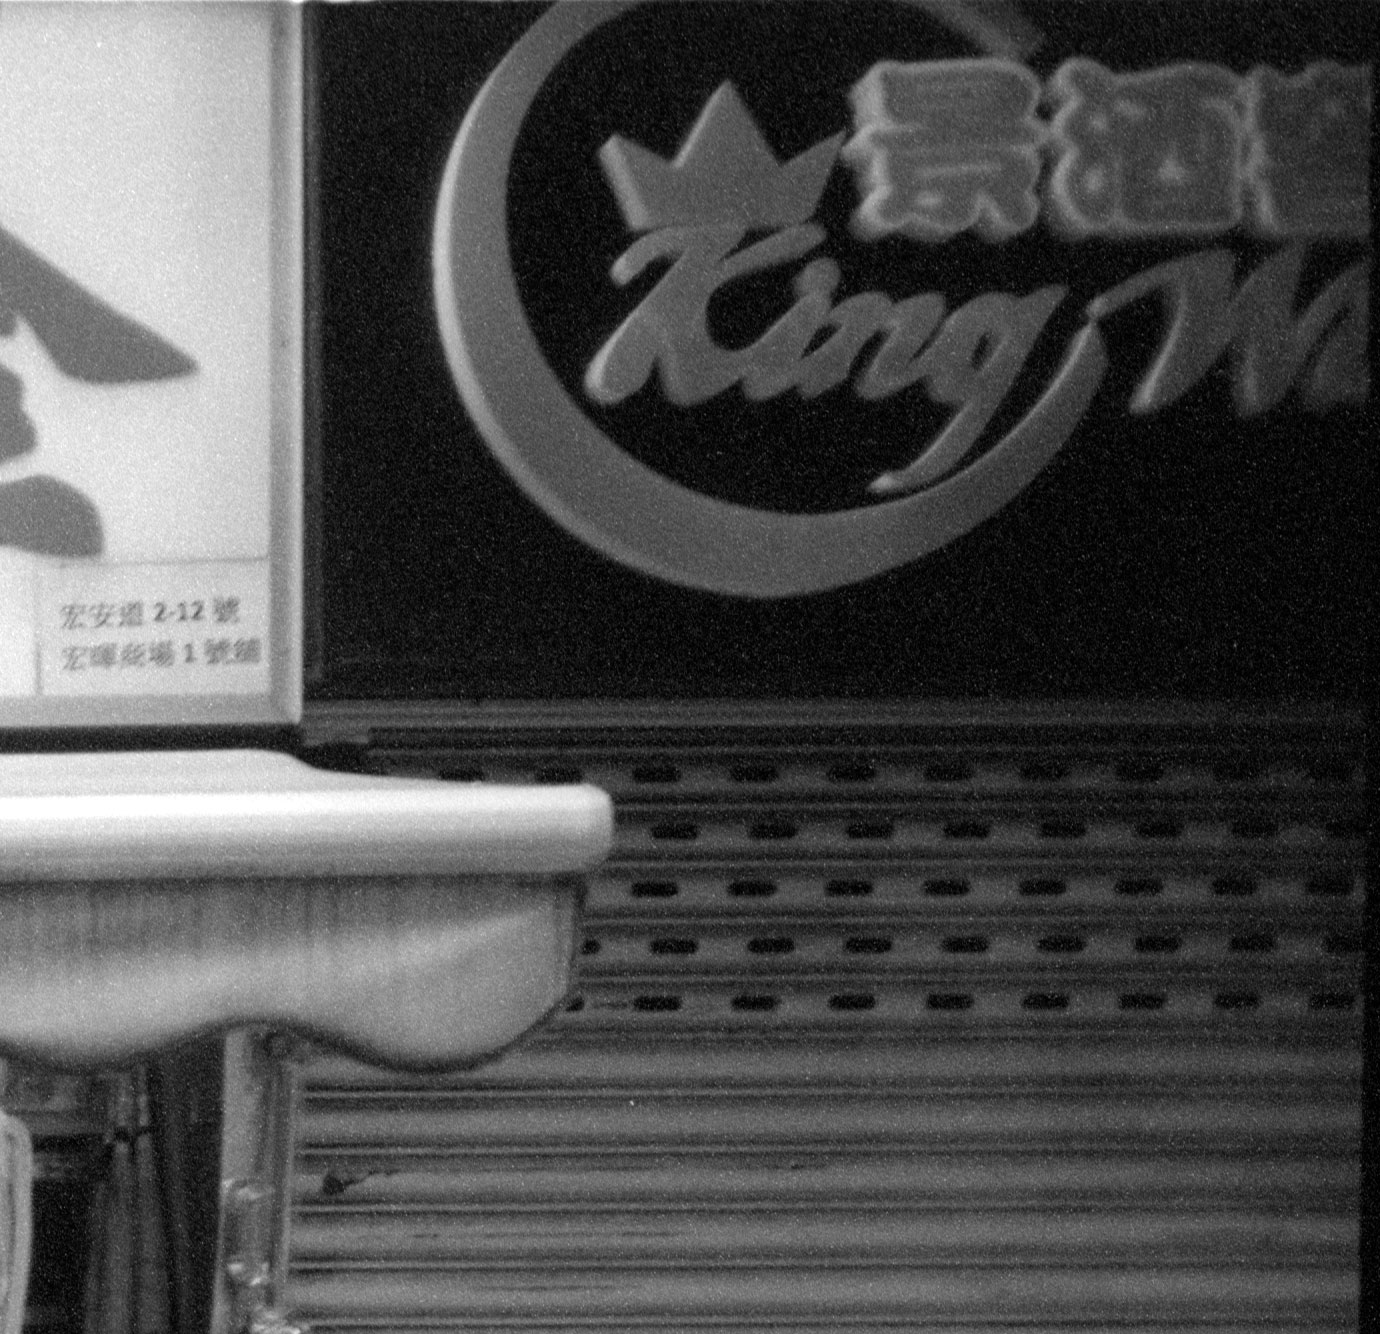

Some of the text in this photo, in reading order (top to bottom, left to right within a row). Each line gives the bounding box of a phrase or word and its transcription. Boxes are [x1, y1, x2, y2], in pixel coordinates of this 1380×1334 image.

[583, 222, 1068, 492] King
[153, 599, 205, 623] 2-12
[184, 643, 197, 664] 1
